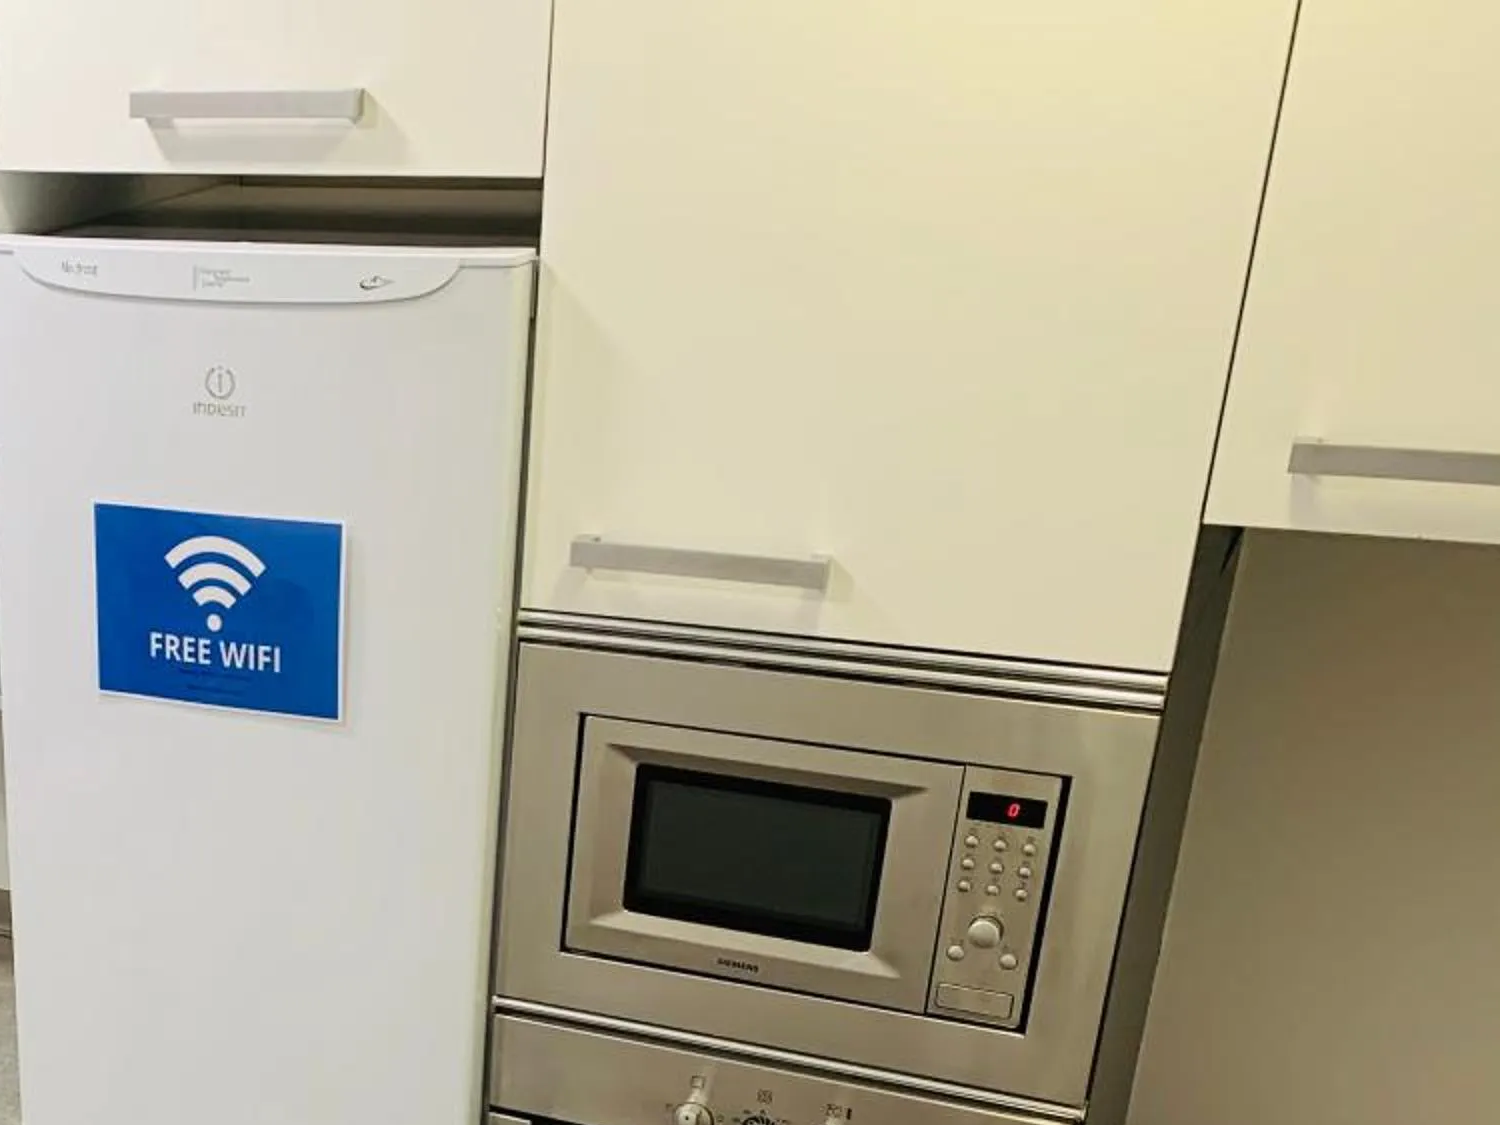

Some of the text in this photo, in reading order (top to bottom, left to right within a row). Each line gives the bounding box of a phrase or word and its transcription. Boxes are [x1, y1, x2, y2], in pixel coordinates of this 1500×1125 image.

[150, 631, 281, 673] FREE WIFI
[1007, 803, 1020, 817] 0
